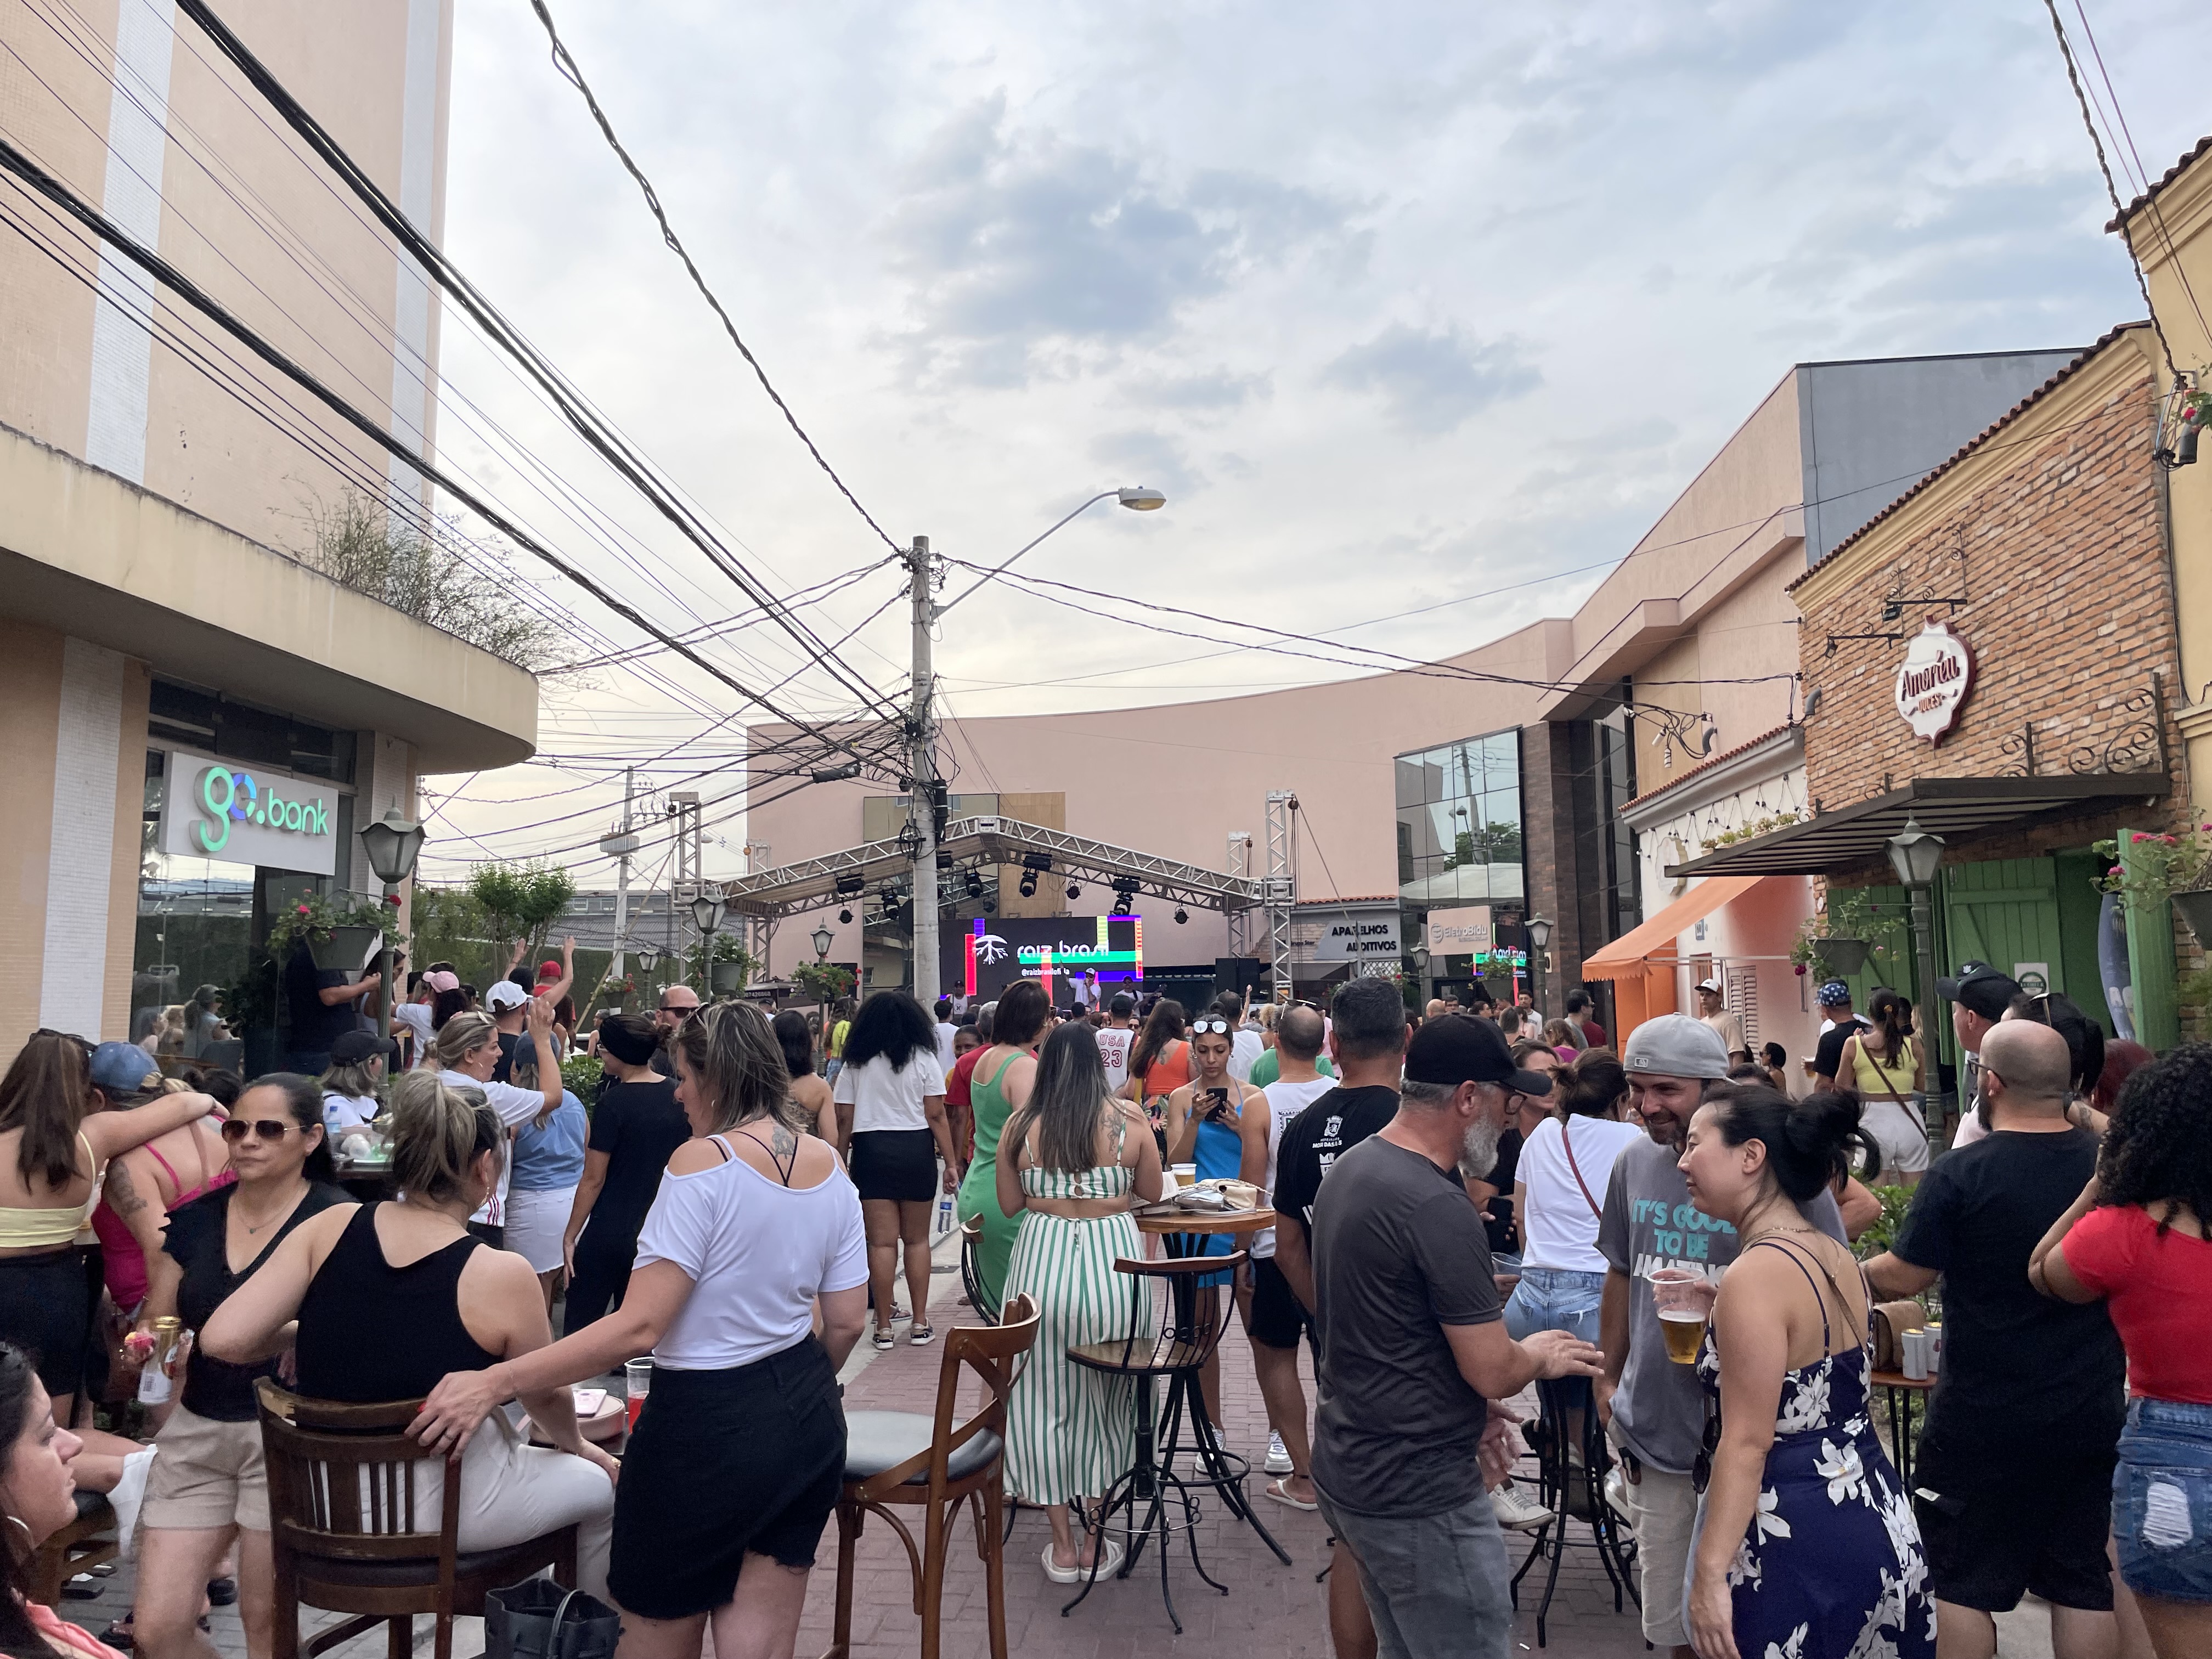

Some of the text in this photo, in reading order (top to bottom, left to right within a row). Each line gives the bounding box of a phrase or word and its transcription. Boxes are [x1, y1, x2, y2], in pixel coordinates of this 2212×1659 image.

[1021, 968, 1070, 976] @raizbrasilofiia
[1099, 1034, 1125, 1047] USA
[1100, 1048, 1122, 1068] 23
[1632, 1199, 1737, 1234] IT'S GOO
[1654, 1228, 1710, 1260] TO BE
